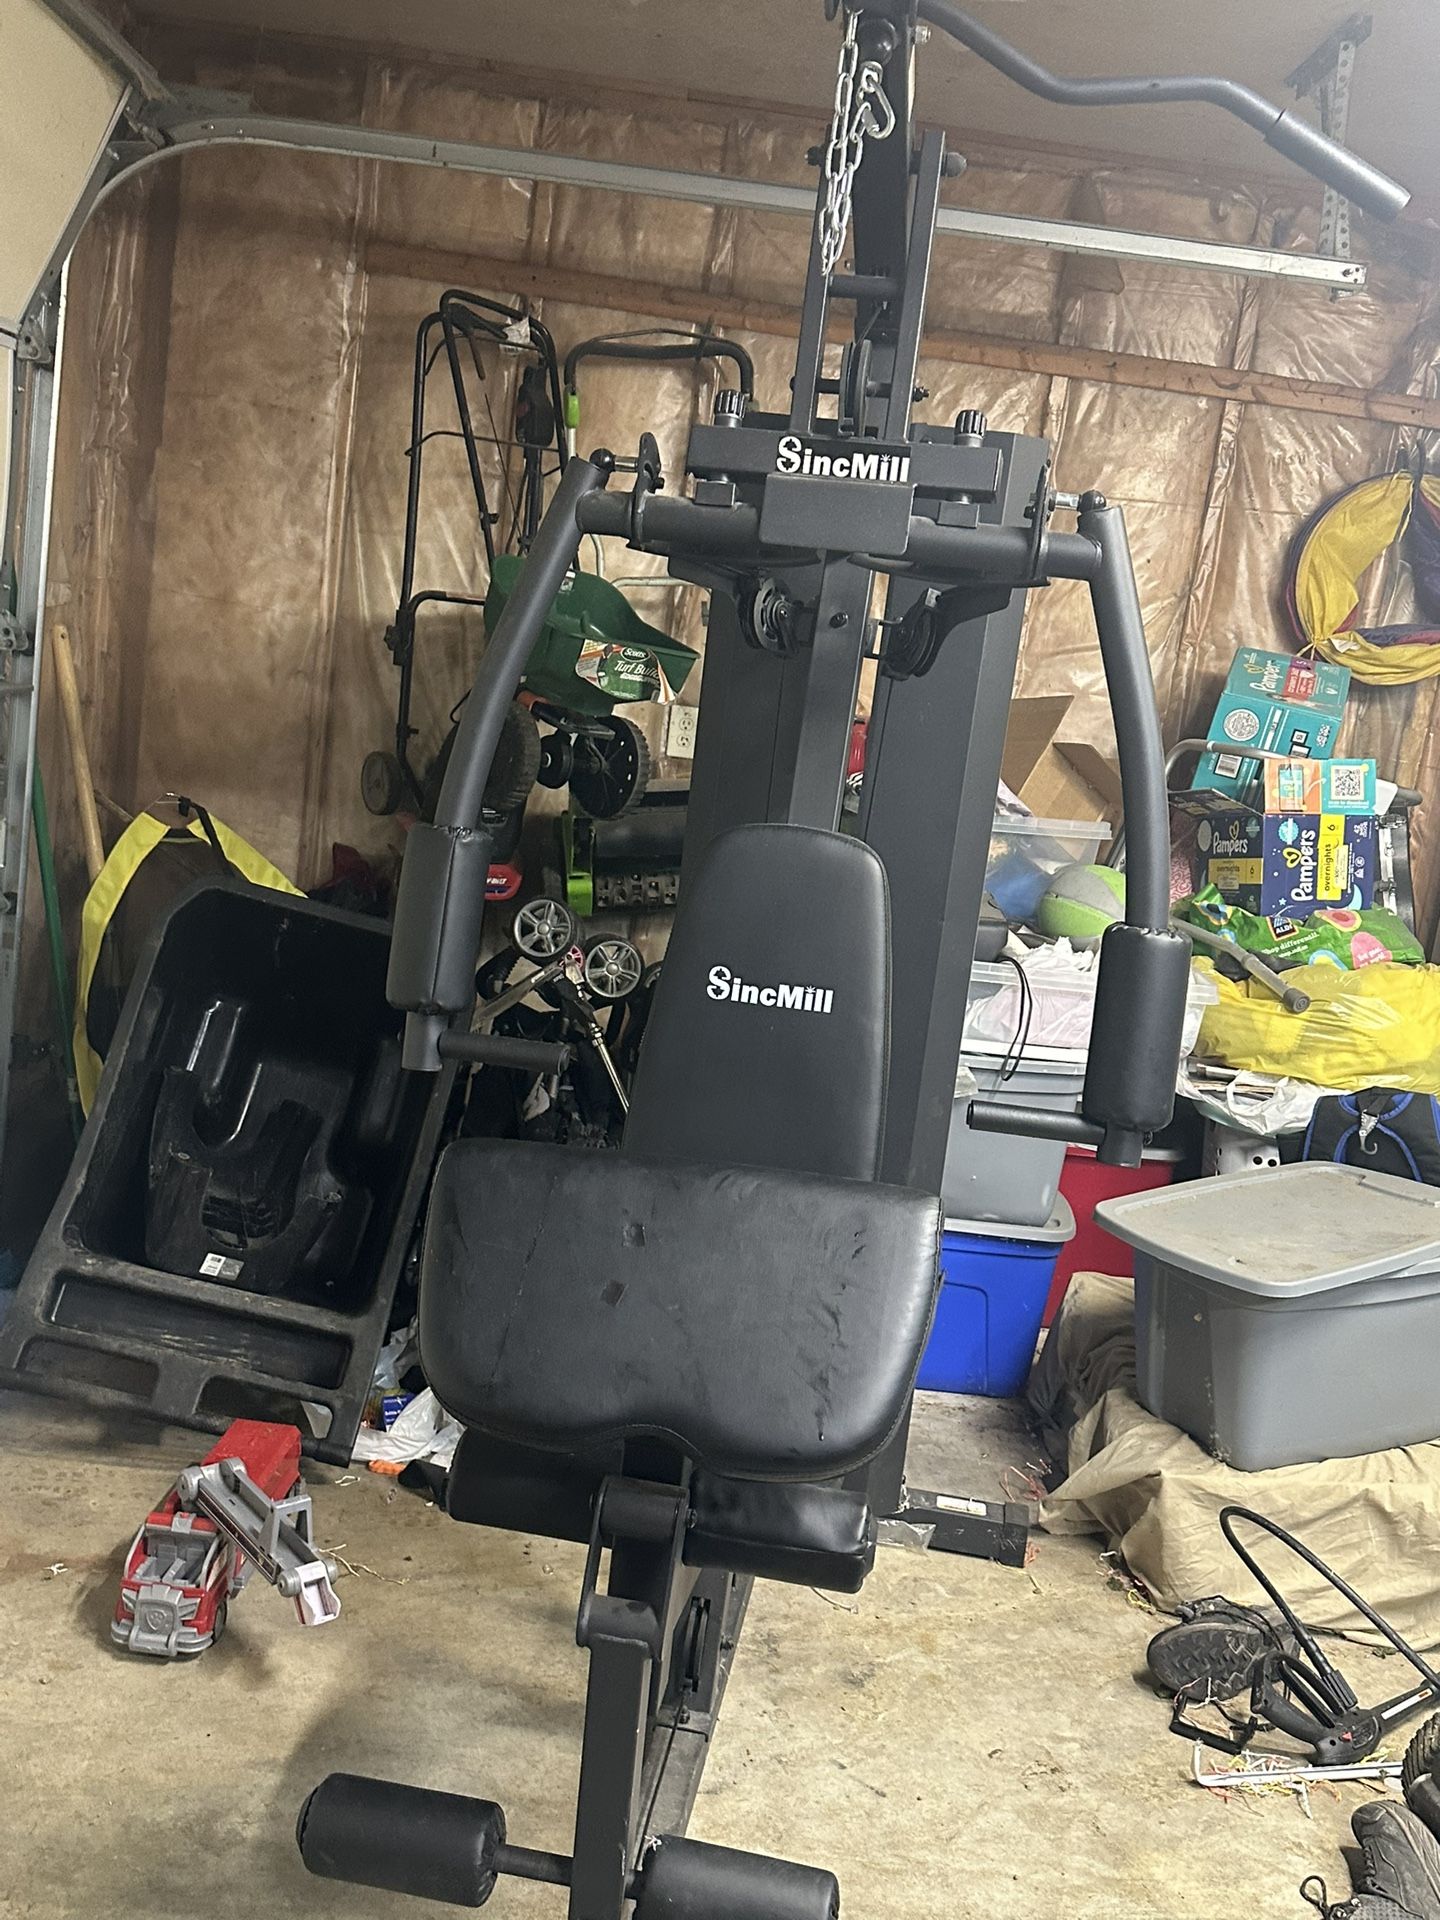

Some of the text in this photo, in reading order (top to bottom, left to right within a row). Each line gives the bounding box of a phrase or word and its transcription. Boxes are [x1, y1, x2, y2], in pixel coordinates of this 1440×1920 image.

[776, 435, 910, 483] SincMill
[614, 660, 637, 673] Turf
[624, 648, 647, 658] Scotts
[1213, 832, 1248, 857] Pampers
[1291, 829, 1317, 902] Pampers
[1324, 844, 1333, 892] overnights
[1275, 923, 1293, 934] ALDI
[706, 965, 834, 1014] SincMill
